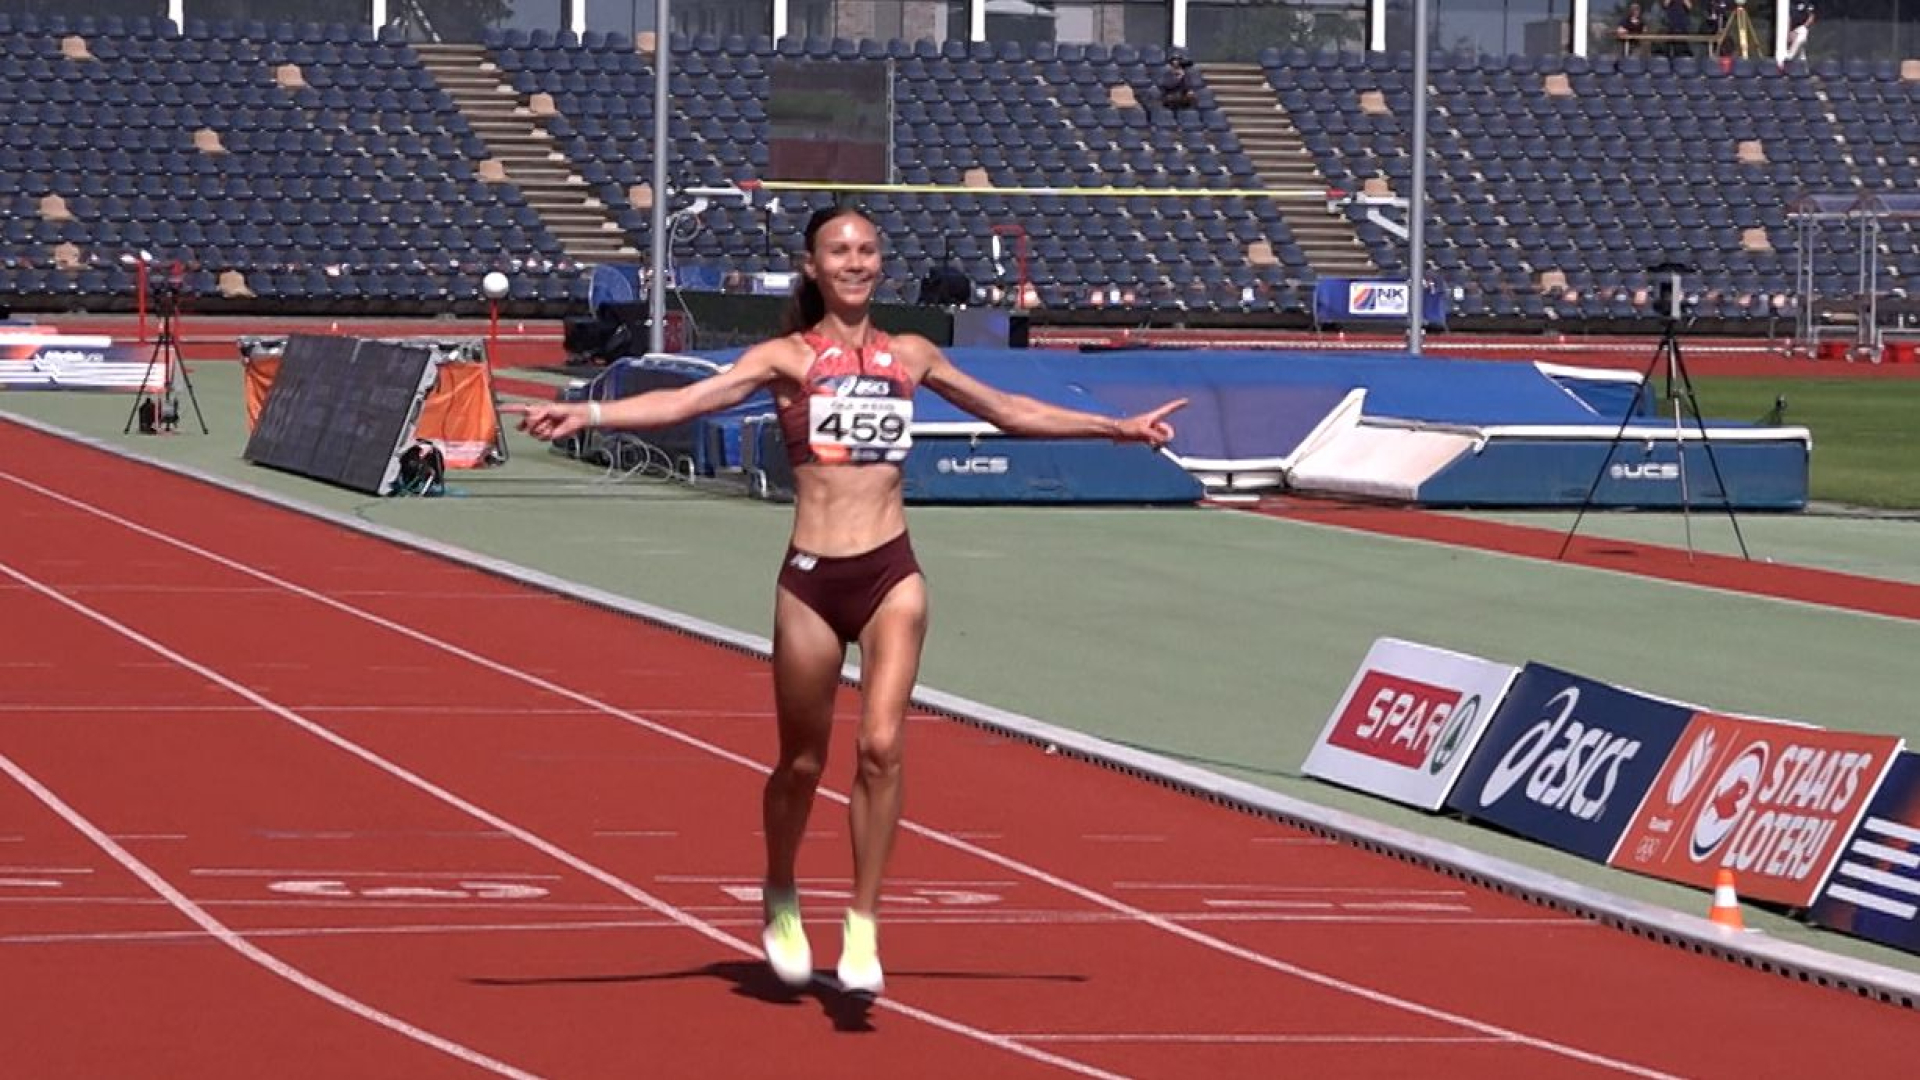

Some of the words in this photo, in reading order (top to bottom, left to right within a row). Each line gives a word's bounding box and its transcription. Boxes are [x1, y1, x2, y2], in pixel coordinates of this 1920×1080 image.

[1377, 287, 1404, 300] NK
[815, 412, 905, 443] 459
[951, 457, 1008, 473] UCS
[1356, 688, 1452, 751] SPAR
[1759, 744, 1873, 814] STAATS
[1721, 810, 1837, 880] LOTERIJ
